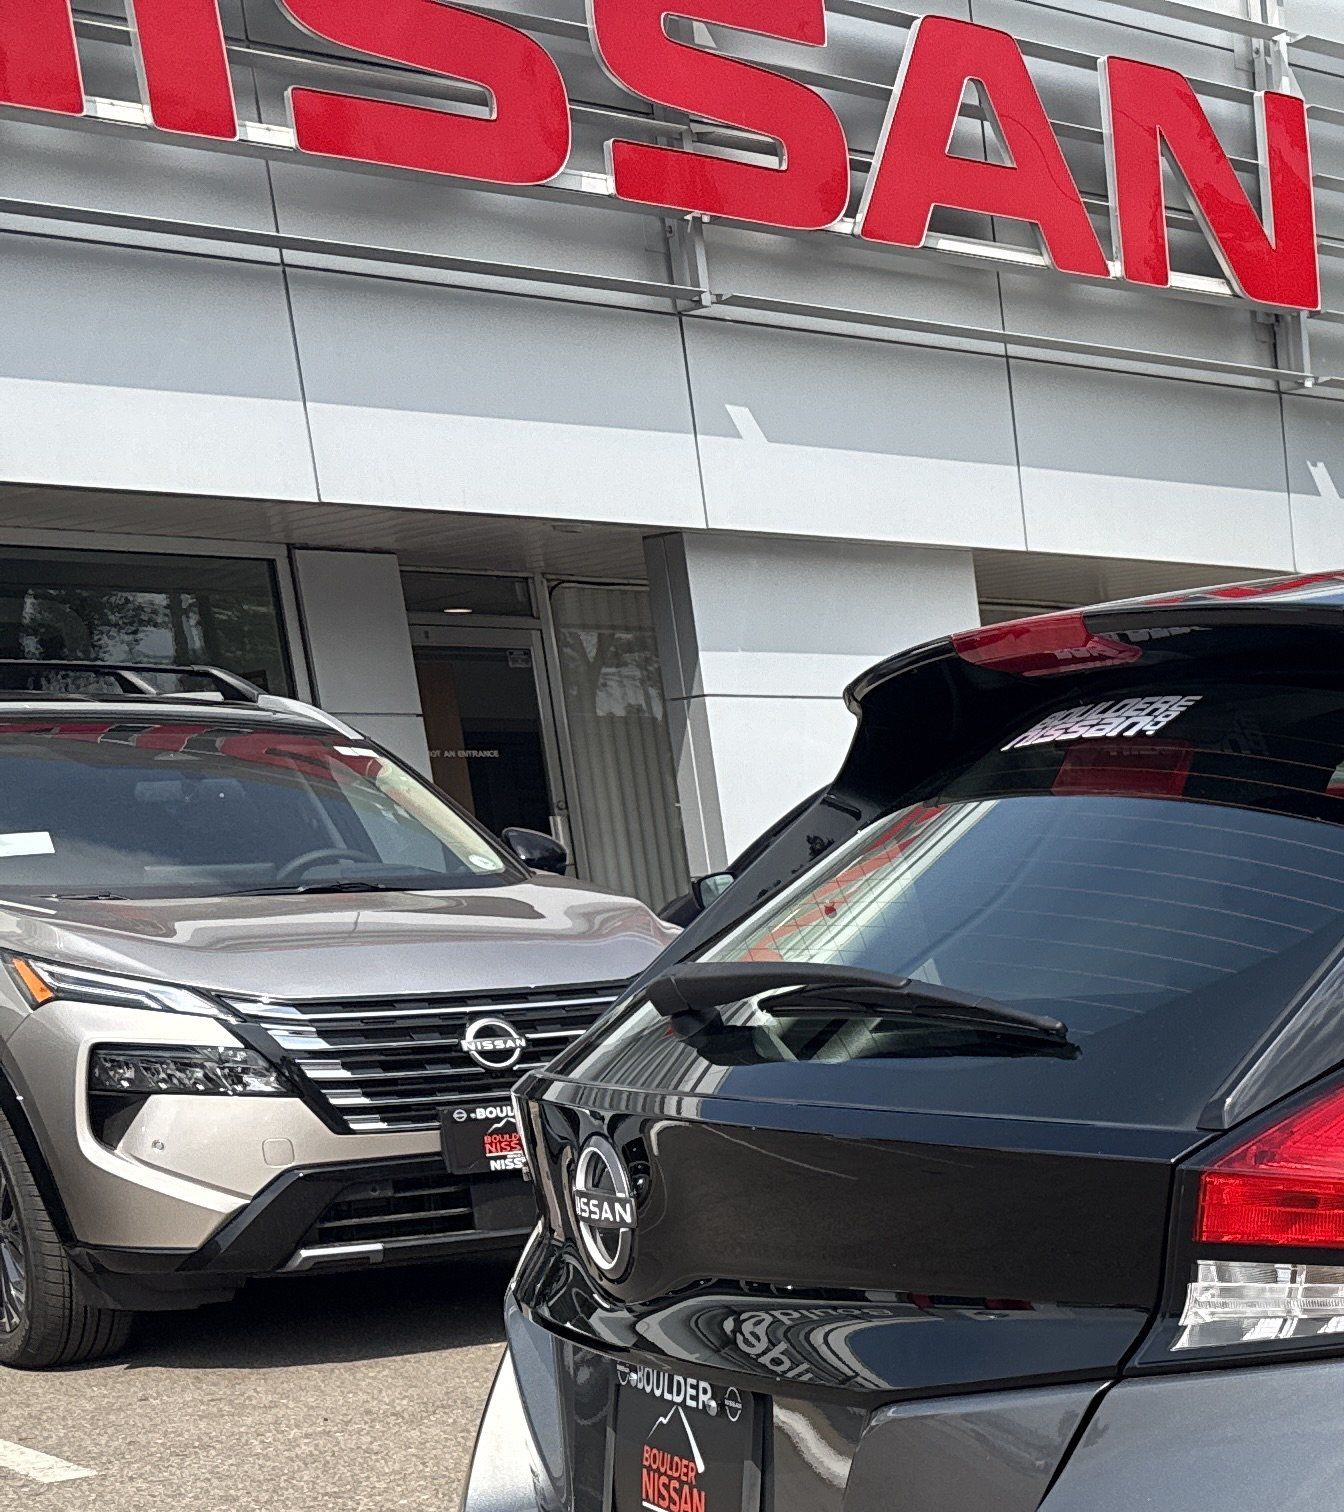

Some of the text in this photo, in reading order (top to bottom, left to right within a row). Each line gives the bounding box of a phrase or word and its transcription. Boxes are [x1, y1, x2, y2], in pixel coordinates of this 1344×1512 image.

[0, 0, 1321, 311] ISSAN
[457, 750, 499, 758] ENTRANCE
[460, 1038, 526, 1051] NISSAN
[475, 1106, 515, 1119] BOUL
[484, 1133, 522, 1143] BOULD
[485, 1141, 521, 1153] NISS
[490, 1157, 526, 1171] NISS
[637, 1365, 712, 1410] BOULDER
[641, 1444, 696, 1485] BOULDER
